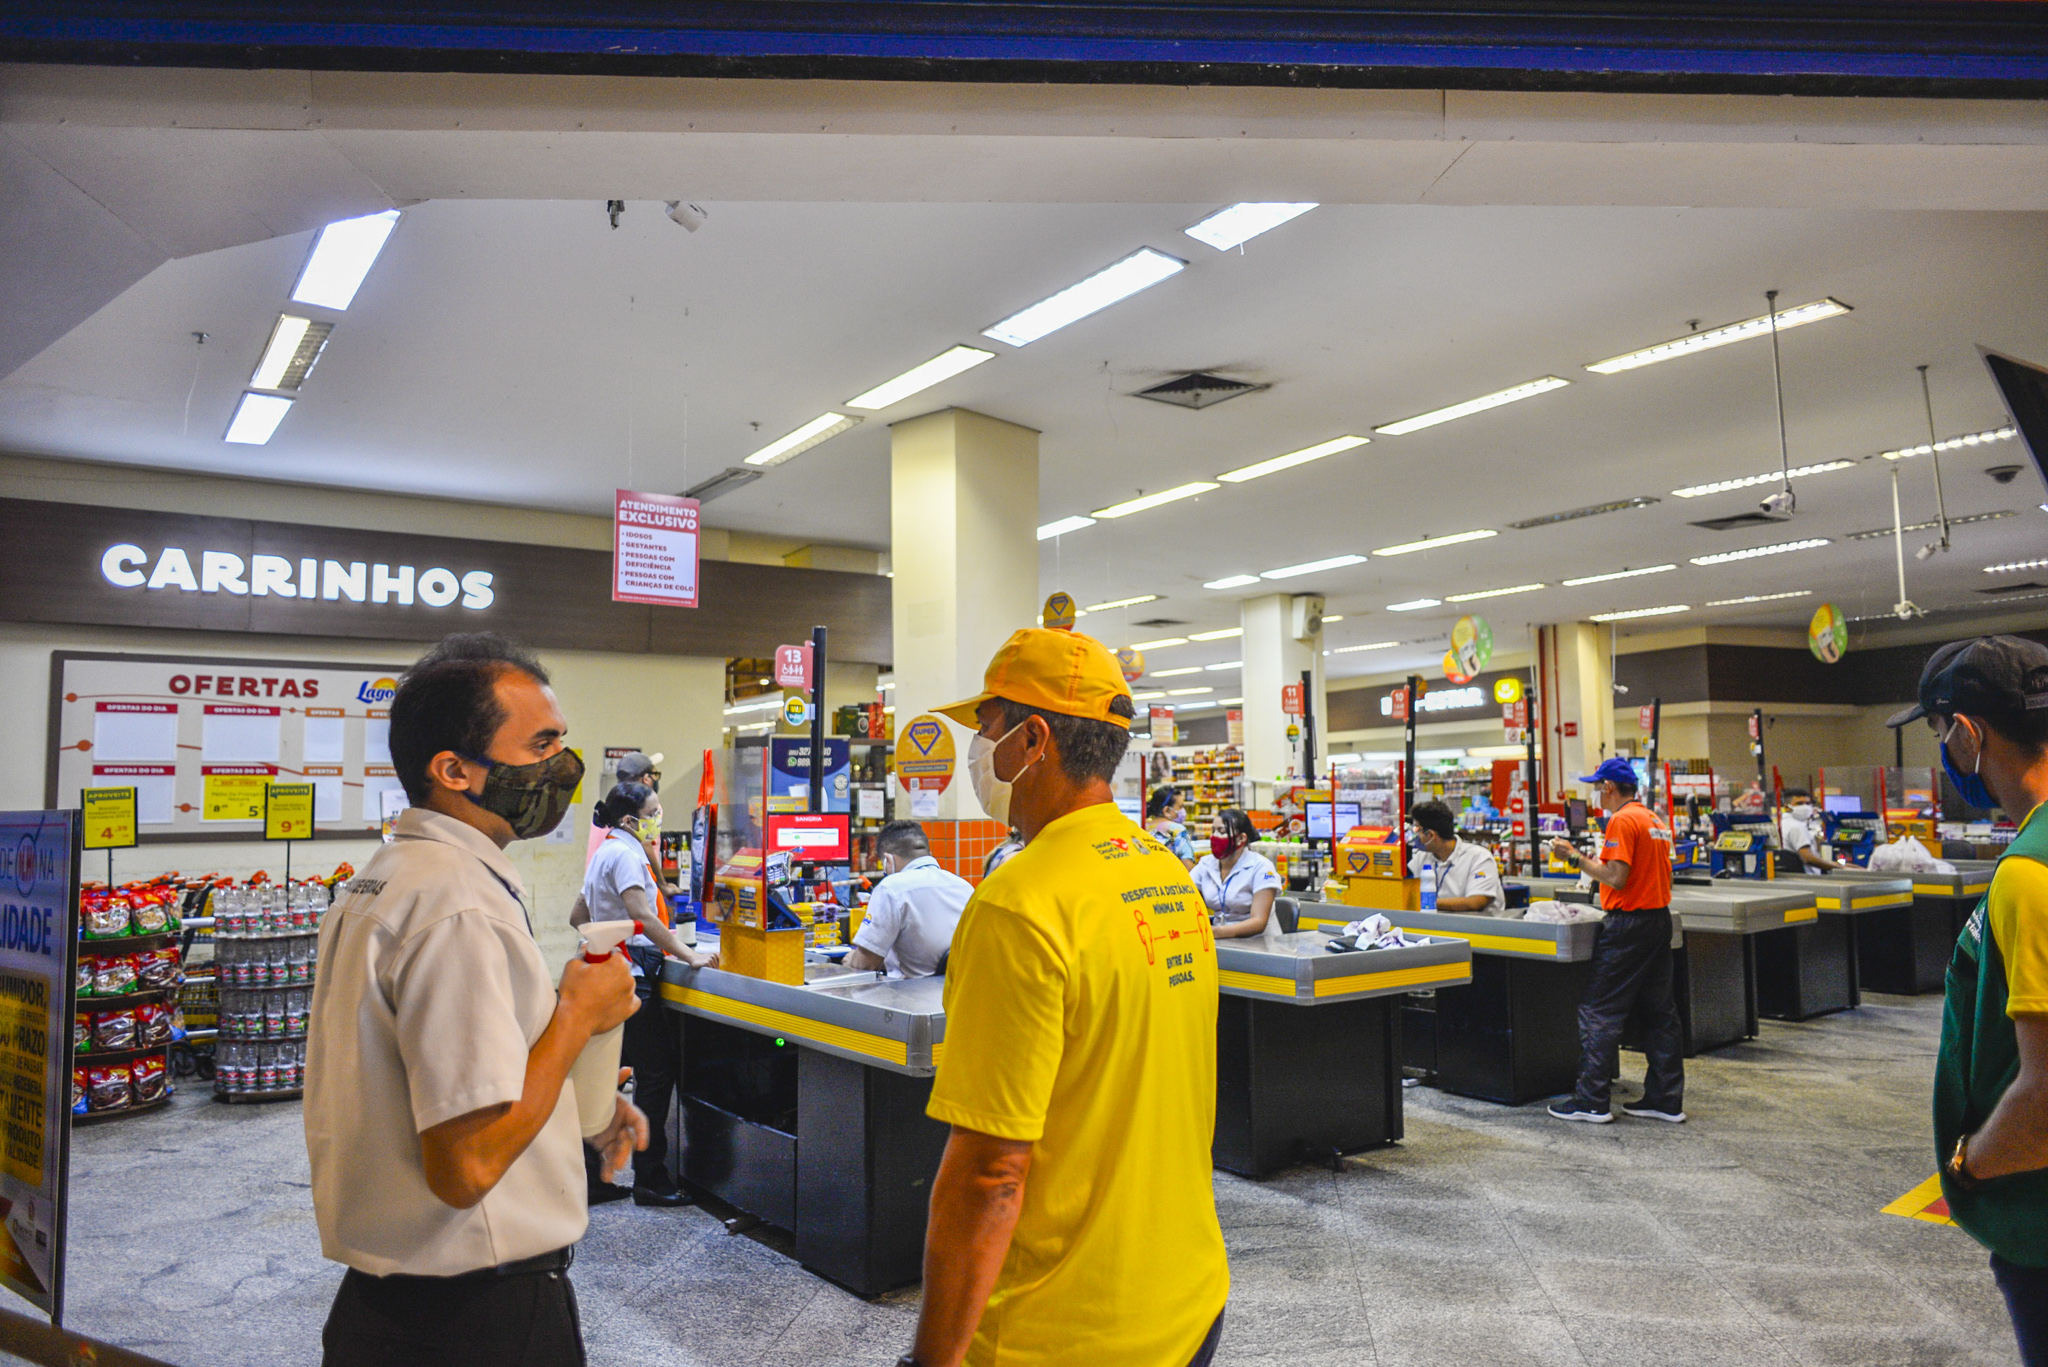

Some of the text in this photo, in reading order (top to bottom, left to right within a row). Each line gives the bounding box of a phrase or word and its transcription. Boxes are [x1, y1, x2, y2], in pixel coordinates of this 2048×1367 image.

[620, 500, 697, 518] ATENDIMENTO
[619, 510, 697, 530] EXCLUSIVO
[626, 532, 653, 540] IDOSOS
[626, 542, 668, 552] GESTANTES
[626, 552, 658, 560] PESSOAS
[626, 560, 672, 571] DEFICIÊNCIA
[100, 543, 494, 610] CARRINHOS
[625, 570, 657, 579] PESSOAS
[626, 580, 662, 589] CRIANÇAS
[784, 649, 802, 664] 13
[168, 674, 319, 698] OFERTAS
[356, 680, 397, 704] Lago
[1287, 687, 1296, 697] 11
[1395, 693, 1404, 702] 10
[38, 848, 54, 880] NA
[1120, 886, 1160, 903] RESPEITE
[1160, 887, 1165, 896] A
[1152, 901, 1185, 914] MÍNIMA DE
[0, 904, 52, 956] IDADE
[1166, 952, 1193, 969] ENTRE AS
[13, 1022, 45, 1057] PRAZO
[4, 1120, 41, 1150] PRODUTO
